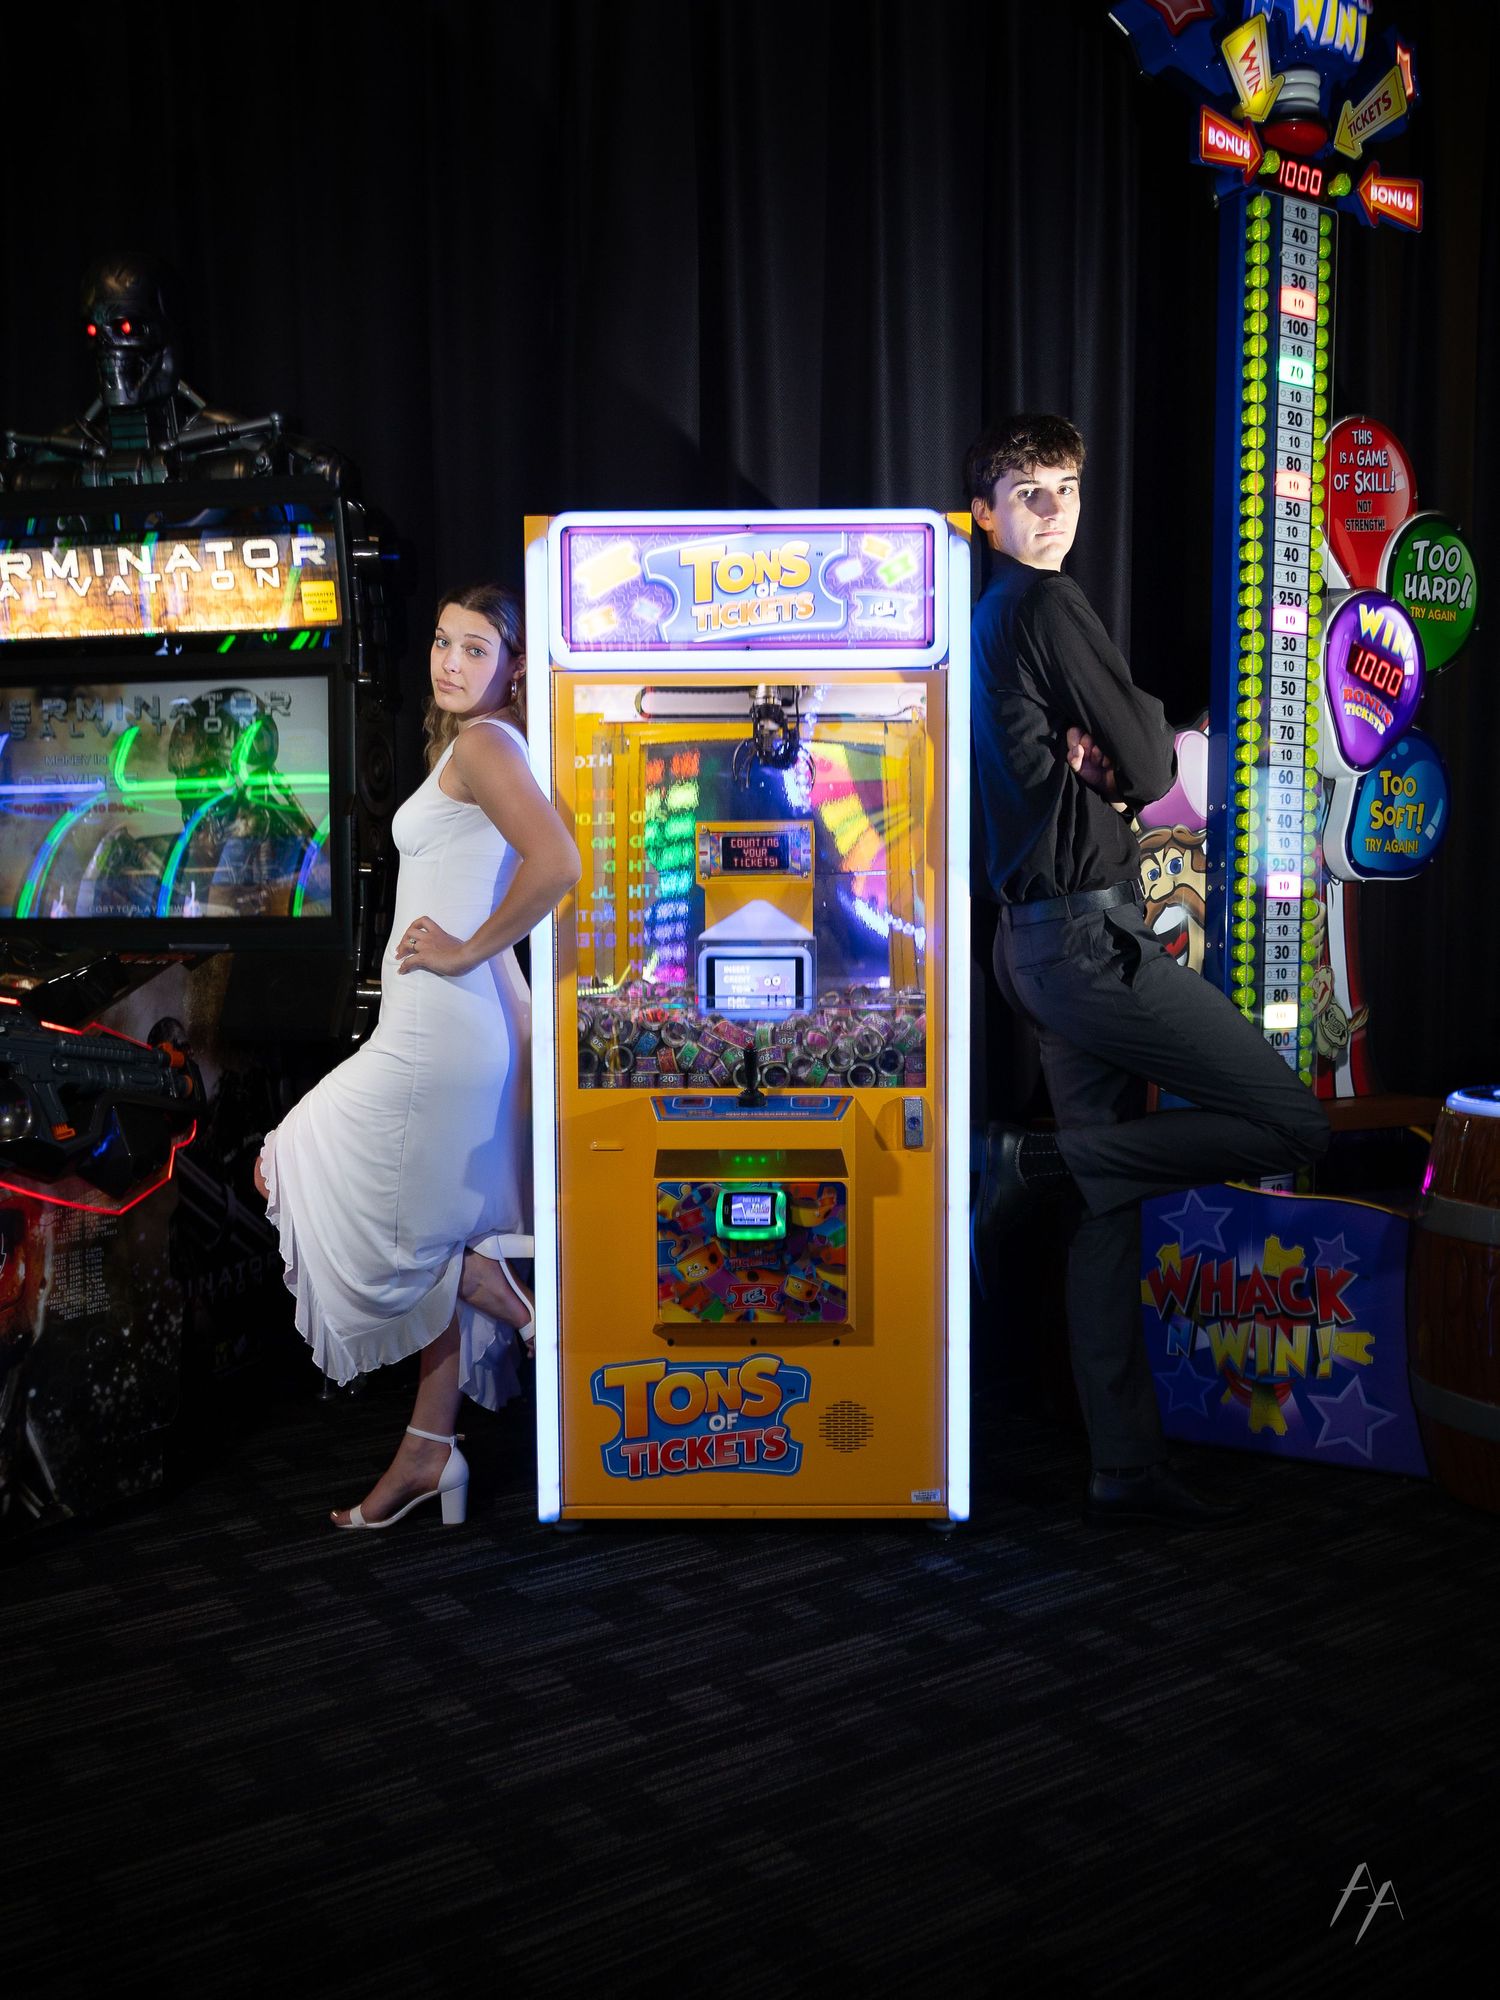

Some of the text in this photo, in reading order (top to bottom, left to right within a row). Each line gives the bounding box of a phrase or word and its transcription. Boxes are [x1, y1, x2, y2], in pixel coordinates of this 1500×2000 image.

[1238, 39, 1262, 97] WIN
[1347, 91, 1392, 137] TICKETS
[1208, 126, 1251, 158] BONUS
[1280, 160, 1322, 196] 1000
[1370, 184, 1413, 210] BONUS
[1295, 207, 1306, 220] 10
[1292, 228, 1308, 244] 40
[1294, 252, 1305, 265] 10
[1291, 274, 1306, 290] 30
[1294, 298, 1304, 308] 10
[1287, 320, 1308, 336] 100
[1292, 345, 1302, 357] 10
[1290, 366, 1303, 378] 70
[1290, 391, 1301, 403] 10
[1288, 410, 1302, 426] 20
[1289, 436, 1300, 448] 10
[1352, 430, 1372, 444] THIS
[1286, 456, 1300, 472] 80
[1340, 450, 1388, 468] IS A GAME
[1289, 480, 1298, 492] 10
[1334, 470, 1396, 494] OF SKILL!
[1285, 502, 1300, 517] 50
[1357, 501, 1372, 513] NOT
[1287, 526, 1298, 538] 10
[1345, 518, 1386, 532] STRENGTH!
[0, 536, 327, 581] RMINATOR
[1284, 546, 1298, 562] 40
[1412, 540, 1462, 572] TOO
[680, 540, 811, 604] TONS
[1286, 572, 1296, 583] 10
[0, 566, 280, 601] ALVATION
[755, 581, 779, 598] OF
[1404, 573, 1473, 609] HARD!
[1280, 591, 1302, 608] 250
[691, 591, 815, 632] TICKETS
[1410, 606, 1457, 622] TRY AGAIN
[1285, 616, 1296, 626] 10
[1358, 603, 1415, 657] WIN
[1282, 637, 1296, 652] 30
[1284, 660, 1294, 672] 10
[1353, 650, 1404, 698] 1000
[1280, 680, 1296, 695] 50
[1282, 706, 1293, 716] 10
[1343, 686, 1394, 726] BONUS
[1344, 702, 1386, 735] TICKETS
[10, 716, 257, 741] SALVTION
[1280, 726, 1294, 740] 70
[44, 753, 109, 767] MONEY IN
[1281, 750, 1292, 760] 10
[1278, 770, 1294, 784] 60
[1379, 770, 1417, 797] TOO
[1280, 793, 1291, 804] 10
[1277, 813, 1292, 828] 40
[1370, 802, 1425, 834] SOFT!
[731, 838, 779, 848] COUNTING
[1279, 838, 1290, 848] 10
[1365, 838, 1418, 854] TRY AGAIN!
[743, 848, 768, 858] YOUR
[733, 857, 778, 867] TICKETS!
[1272, 858, 1295, 872] 250
[1279, 881, 1290, 890] 10
[1276, 902, 1290, 916] 70
[1277, 925, 1288, 936] 10
[1275, 946, 1290, 960] 30
[1276, 968, 1286, 979] 10
[1274, 988, 1288, 1002] 80
[1270, 1032, 1290, 1046] 100
[1147, 1253, 1359, 1326] WHACK
[1166, 1320, 1336, 1380] N WIN!
[603, 1357, 782, 1439] TONS
[709, 1413, 739, 1432] OF
[621, 1426, 788, 1478] TICKETS
